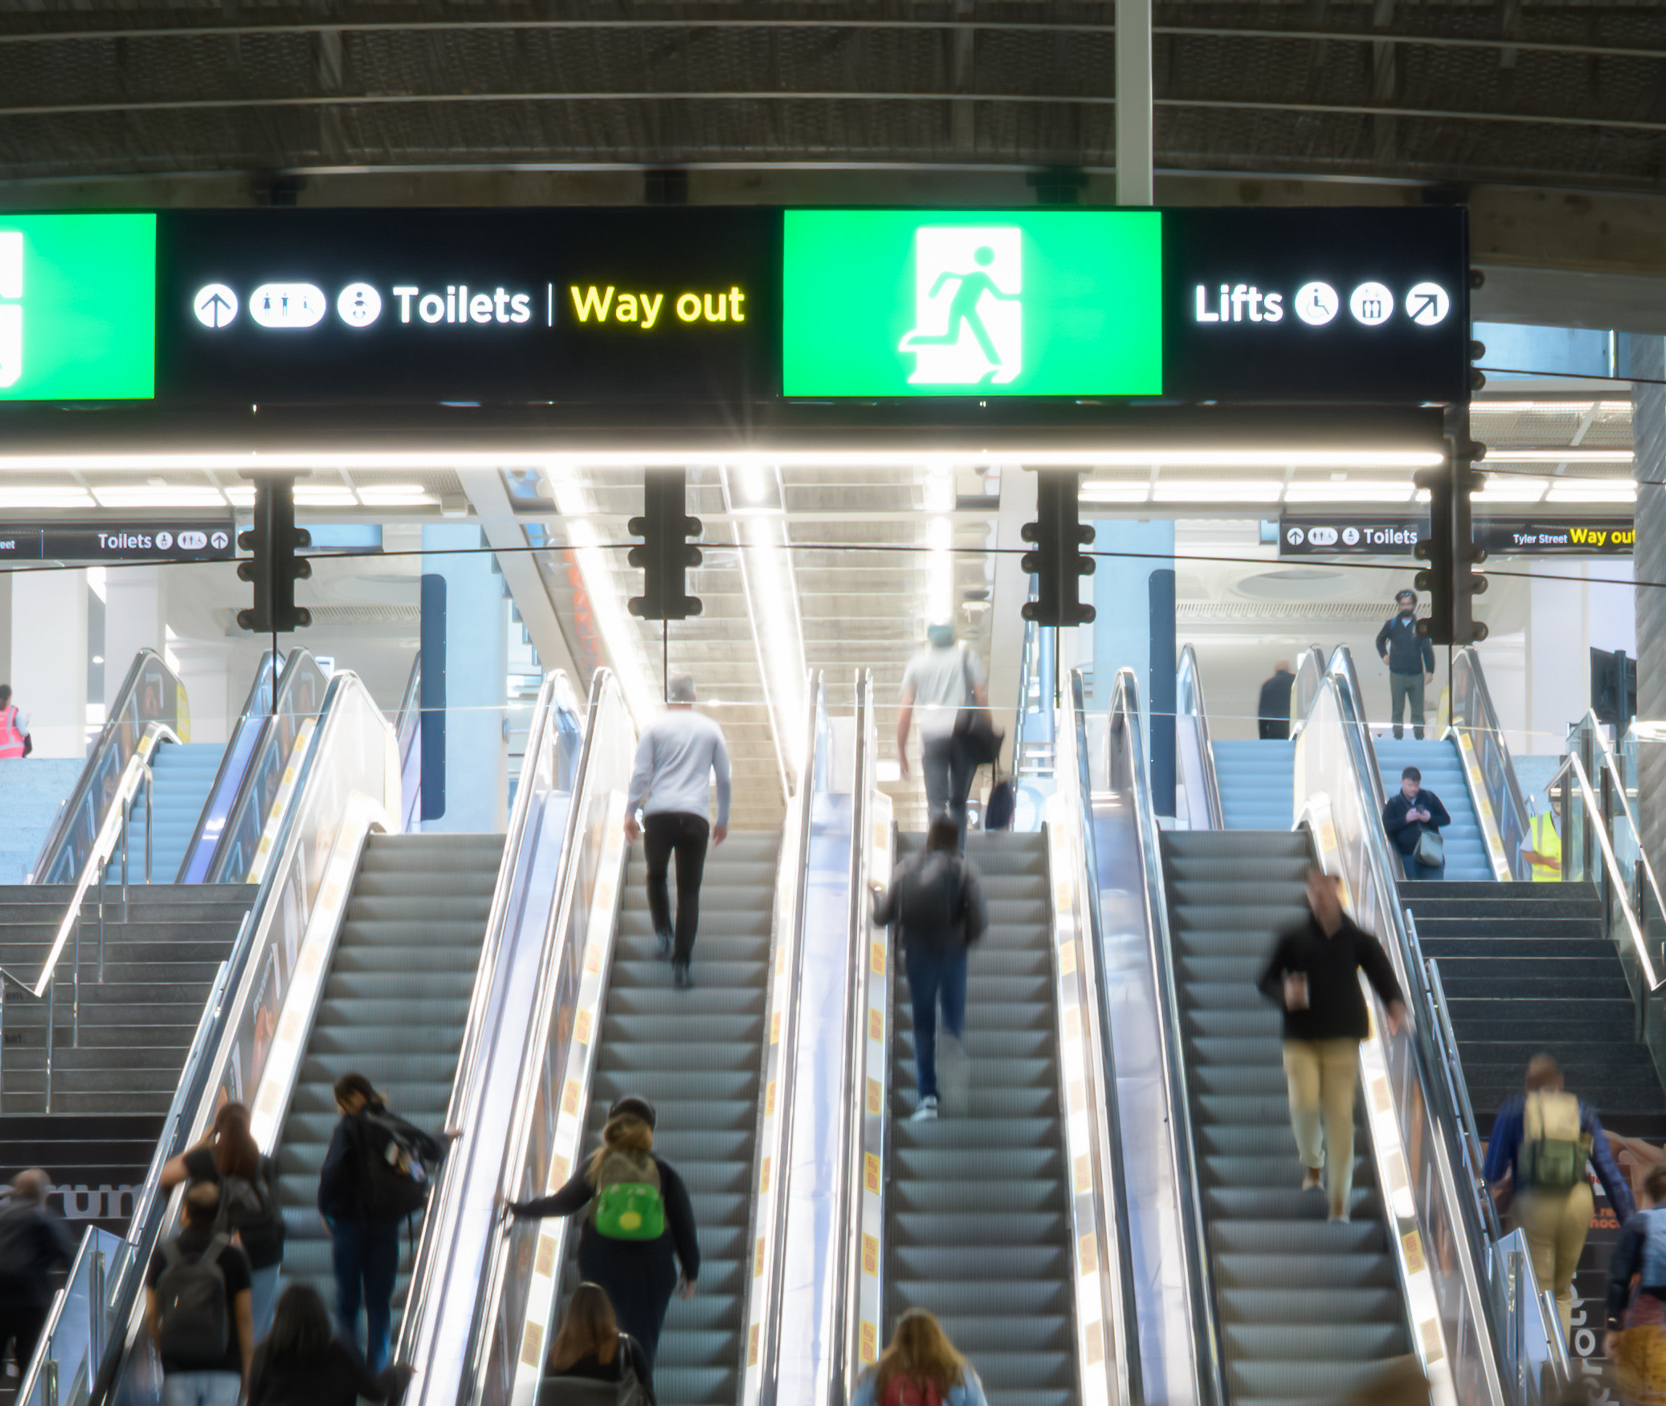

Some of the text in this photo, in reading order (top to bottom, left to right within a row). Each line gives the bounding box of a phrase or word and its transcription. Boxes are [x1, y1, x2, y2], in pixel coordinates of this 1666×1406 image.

[393, 285, 531, 324] Toilets
[570, 286, 744, 328] Way out
[1195, 285, 1283, 323] Lifts
[98, 533, 152, 549] Toilets
[1364, 528, 1417, 544] Toilets
[1513, 533, 1537, 545] Tyler
[1539, 533, 1568, 544] Street
[1570, 528, 1607, 546] Way
